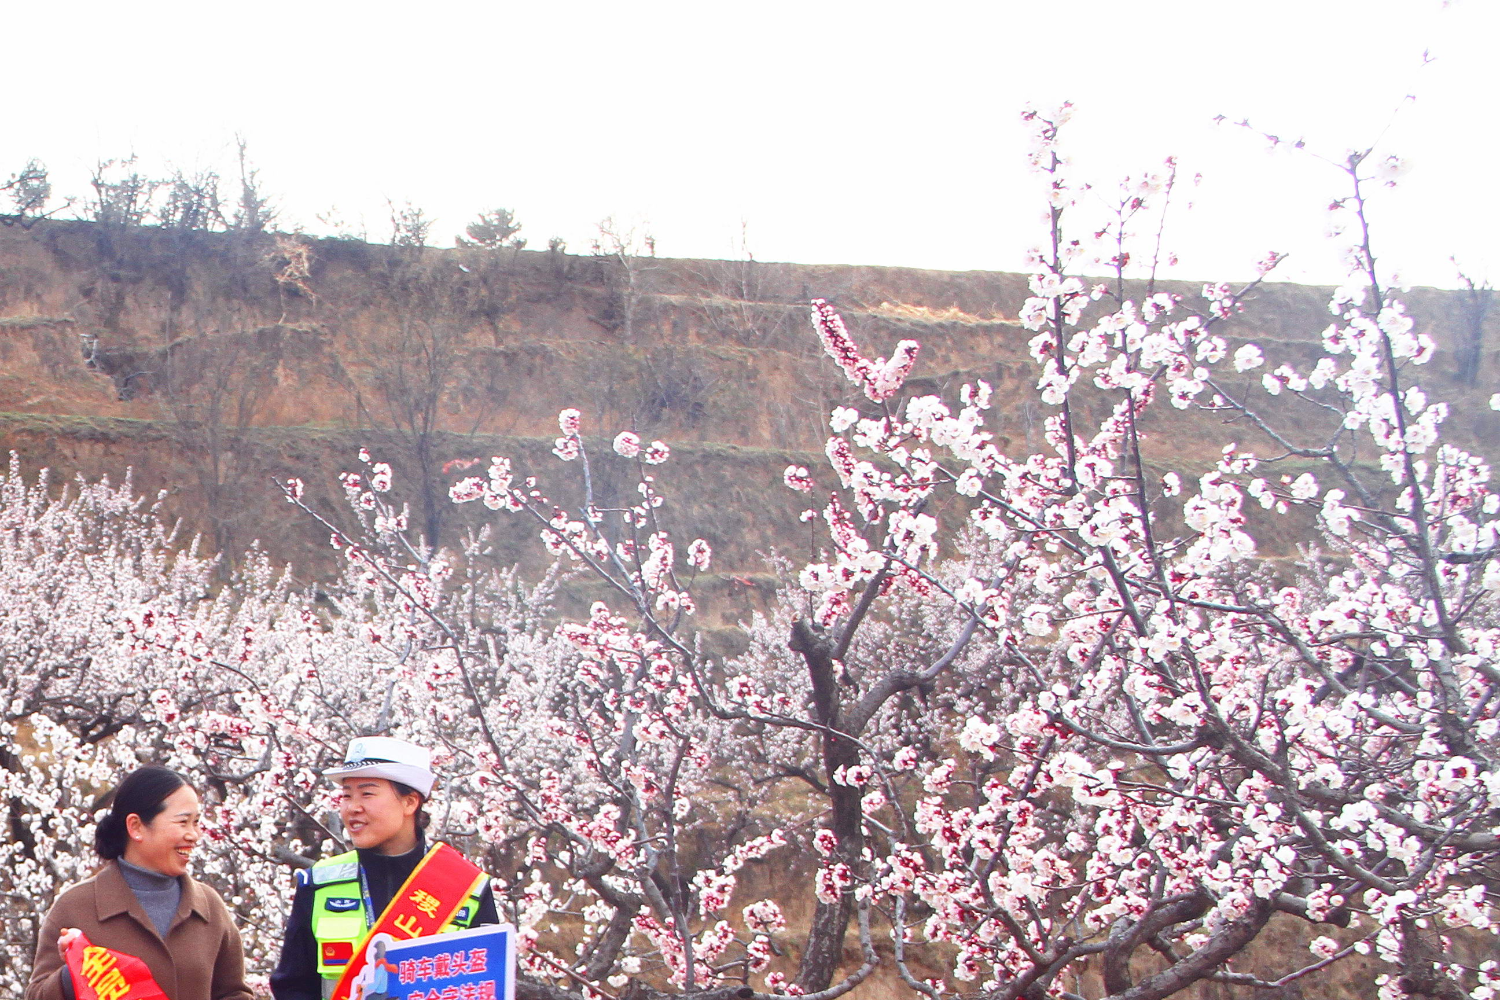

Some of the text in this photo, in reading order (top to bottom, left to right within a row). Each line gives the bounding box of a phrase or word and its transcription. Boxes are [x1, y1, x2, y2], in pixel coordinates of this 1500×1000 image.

[399, 948, 488, 984] 骑车戴头盔
